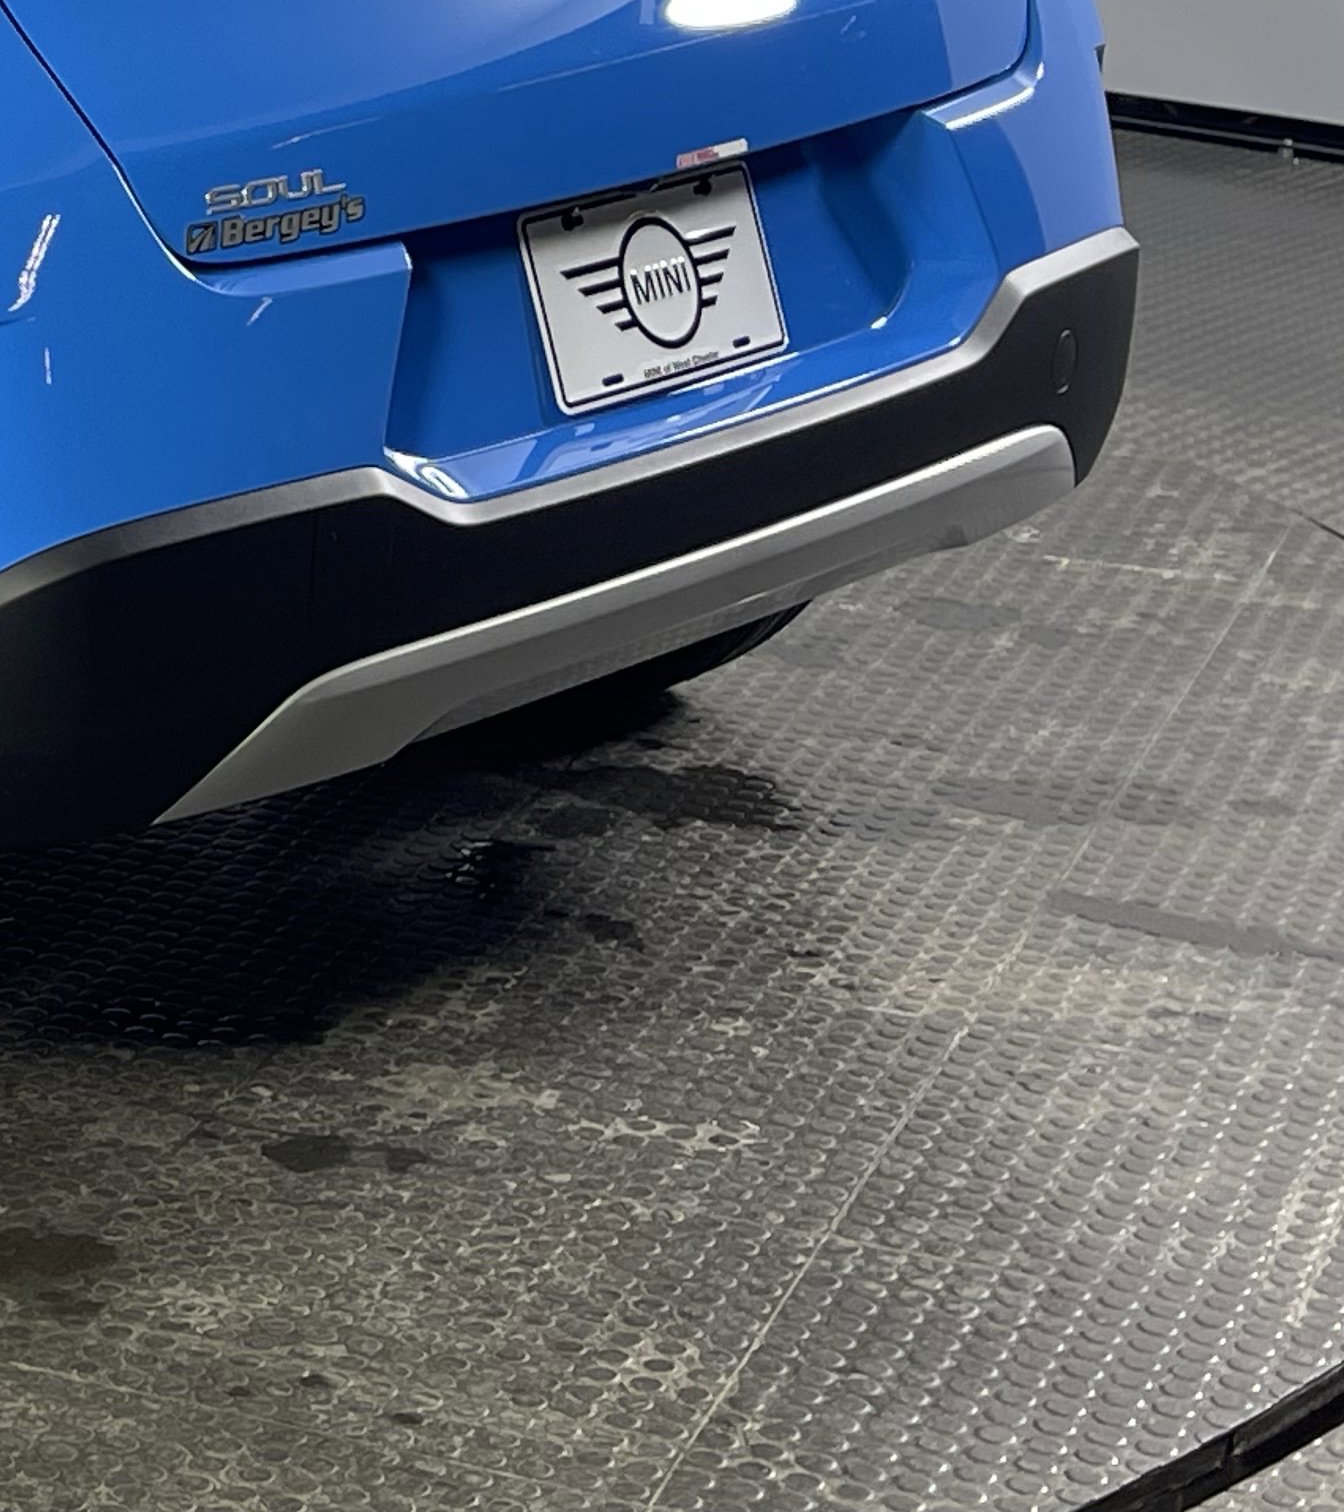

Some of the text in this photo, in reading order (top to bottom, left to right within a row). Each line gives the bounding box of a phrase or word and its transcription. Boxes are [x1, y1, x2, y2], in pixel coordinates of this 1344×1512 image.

[205, 168, 347, 215] SOUL
[221, 193, 366, 249] Bergey's
[630, 256, 691, 305] MINI
